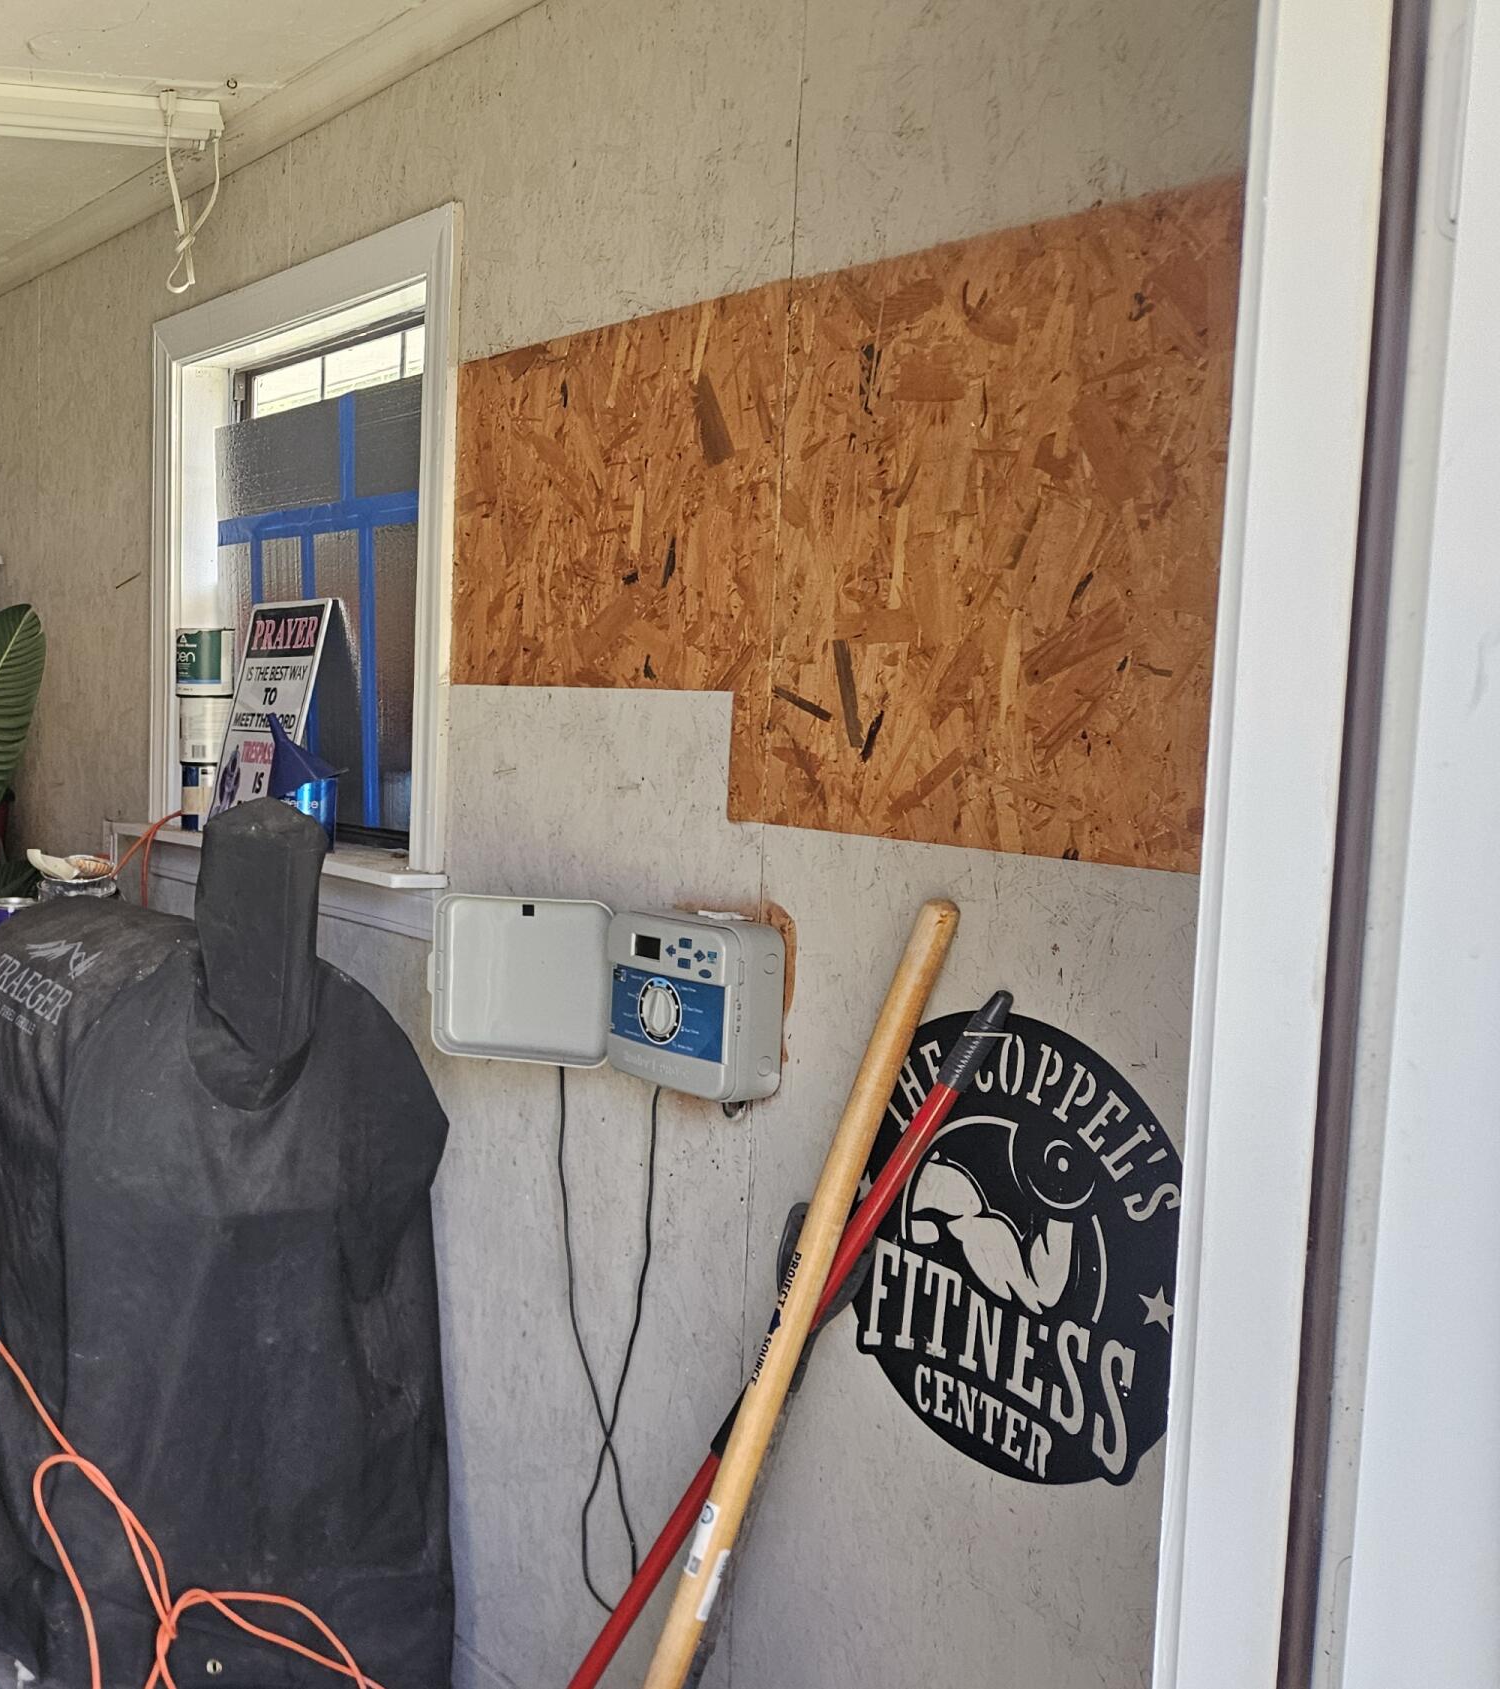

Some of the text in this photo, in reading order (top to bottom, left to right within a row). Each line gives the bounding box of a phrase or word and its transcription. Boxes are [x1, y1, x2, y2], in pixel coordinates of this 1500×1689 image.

[251, 615, 319, 651] PRAYER
[247, 665, 309, 681] IS THE BEST WAY
[262, 687, 278, 706] TO
[232, 712, 256, 728] MEET
[276, 713, 296, 729] ORD
[252, 771, 265, 794] IS
[750, 1335, 772, 1386] SOURCE
[863, 1236, 1136, 1475] FITNESS
[913, 1363, 1053, 1479] CENTER
